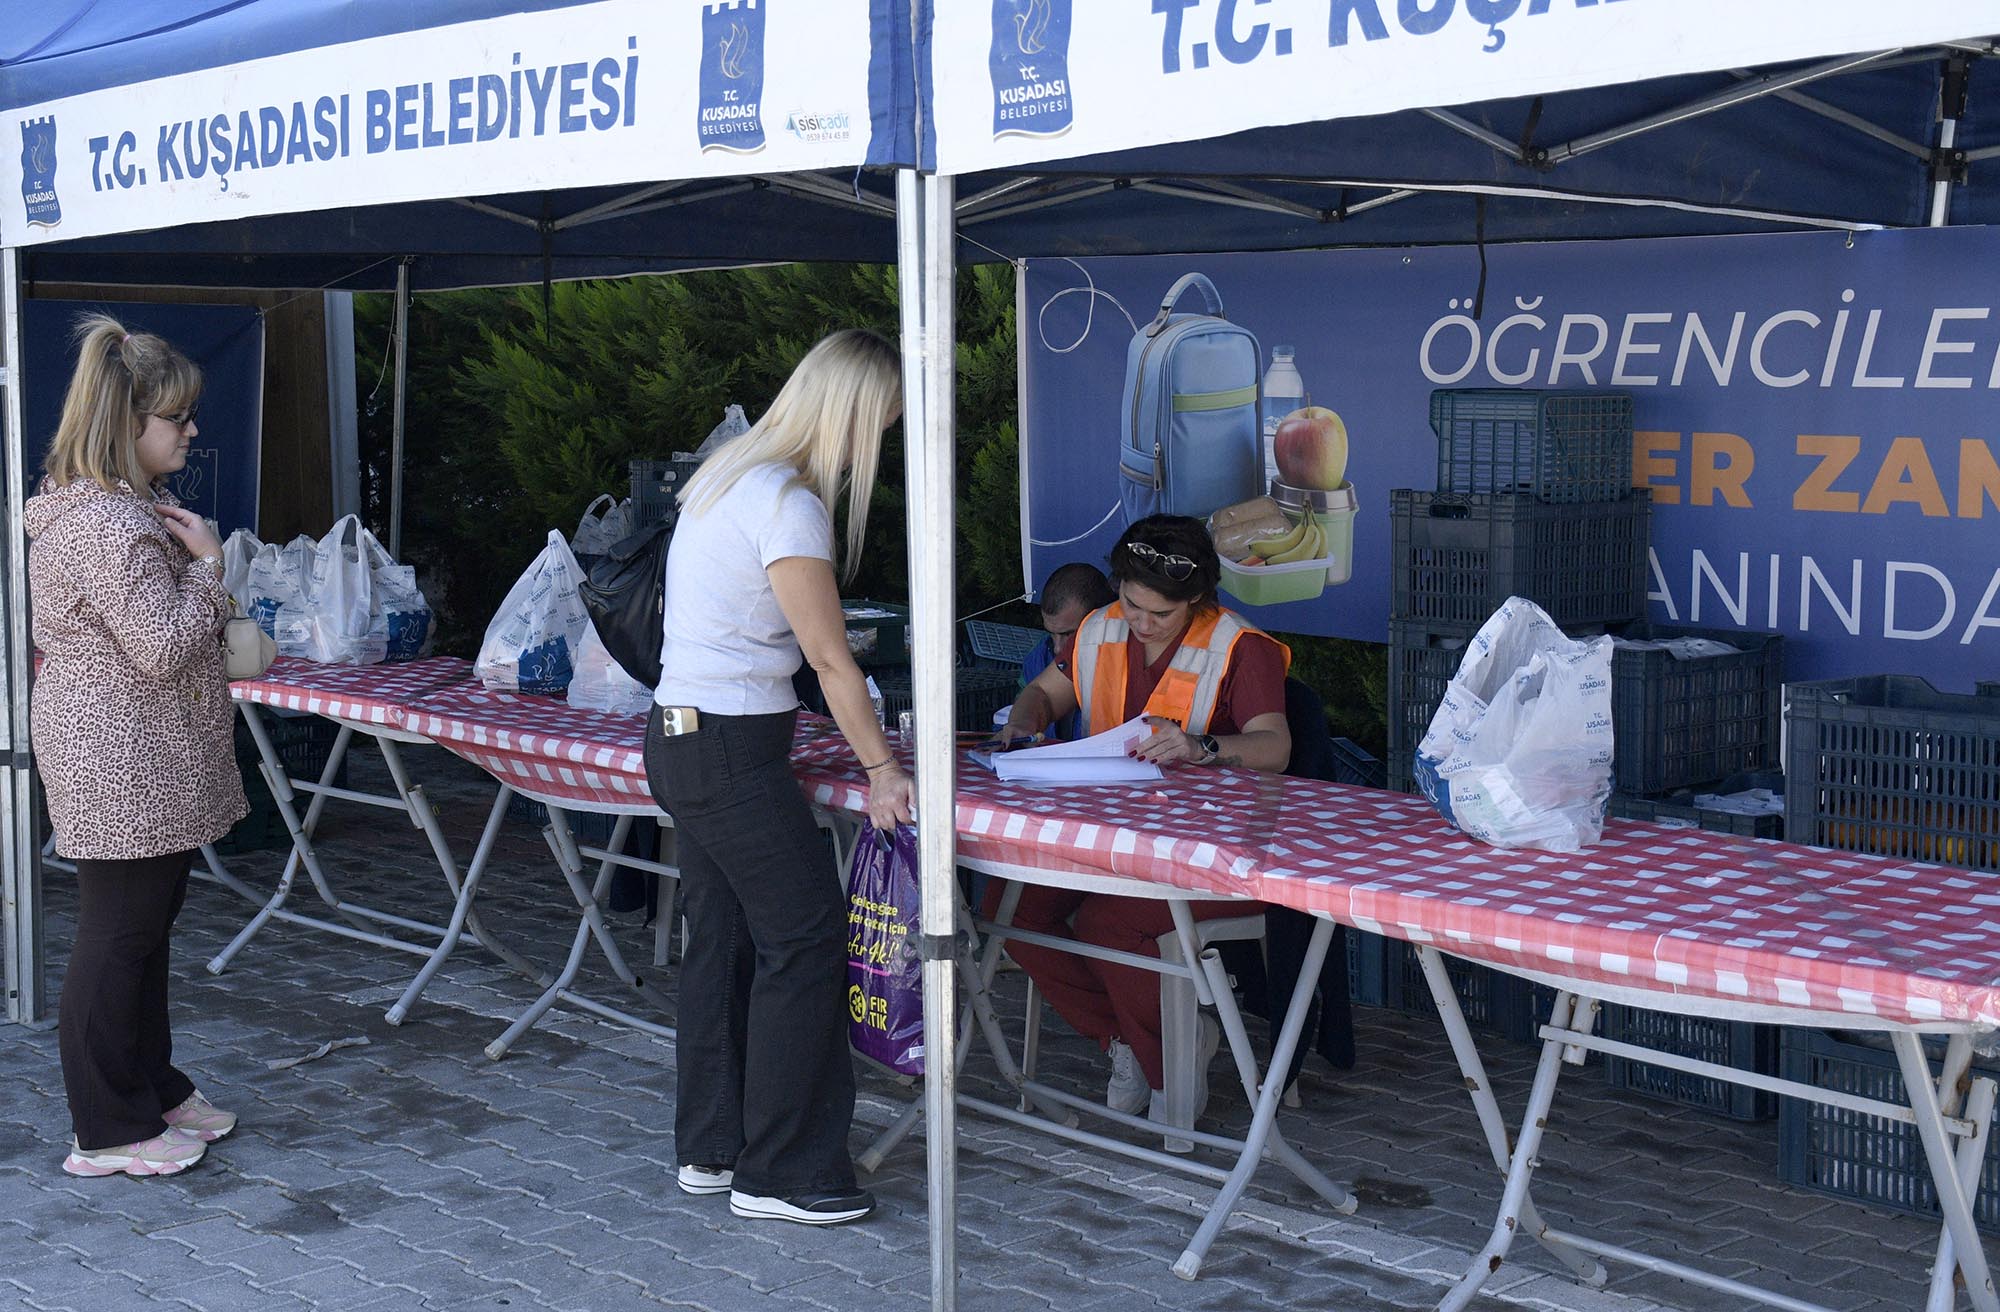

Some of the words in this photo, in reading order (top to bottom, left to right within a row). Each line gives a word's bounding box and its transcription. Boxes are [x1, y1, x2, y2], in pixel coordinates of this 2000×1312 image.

[88, 130, 147, 192] T.C.
[157, 94, 350, 192] KUŞADASI
[366, 36, 639, 154] BELEDİYESİ
[723, 90, 739, 102] T.C.
[1000, 97, 1067, 120] BELEDİYESİ
[702, 120, 758, 135] BELEDİYESİ
[1419, 288, 2000, 389] ÖĞRENCİLE
[1632, 431, 1755, 509] ER
